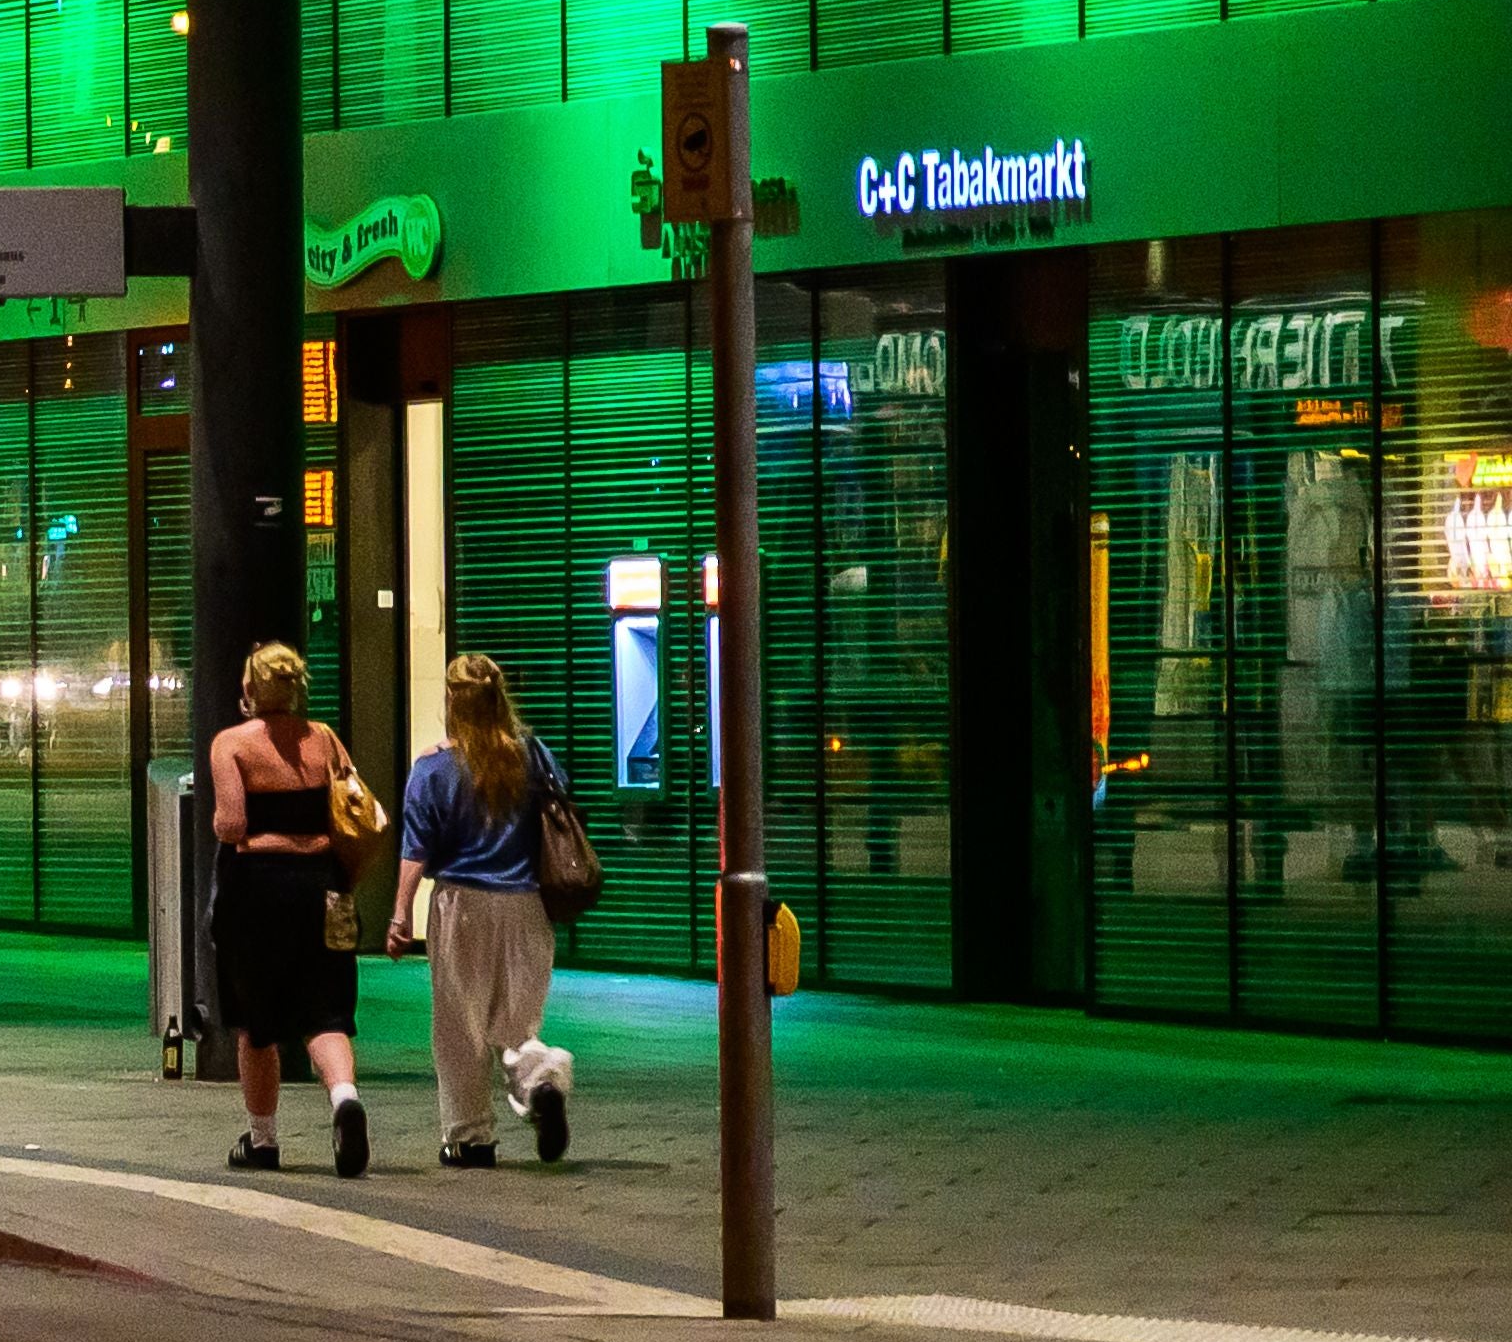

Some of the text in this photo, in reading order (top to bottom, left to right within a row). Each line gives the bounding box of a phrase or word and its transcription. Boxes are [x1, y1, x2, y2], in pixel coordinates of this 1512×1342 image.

[858, 154, 915, 217] C+C
[922, 137, 1087, 210] Tabakmarkt
[357, 209, 399, 252] fresh
